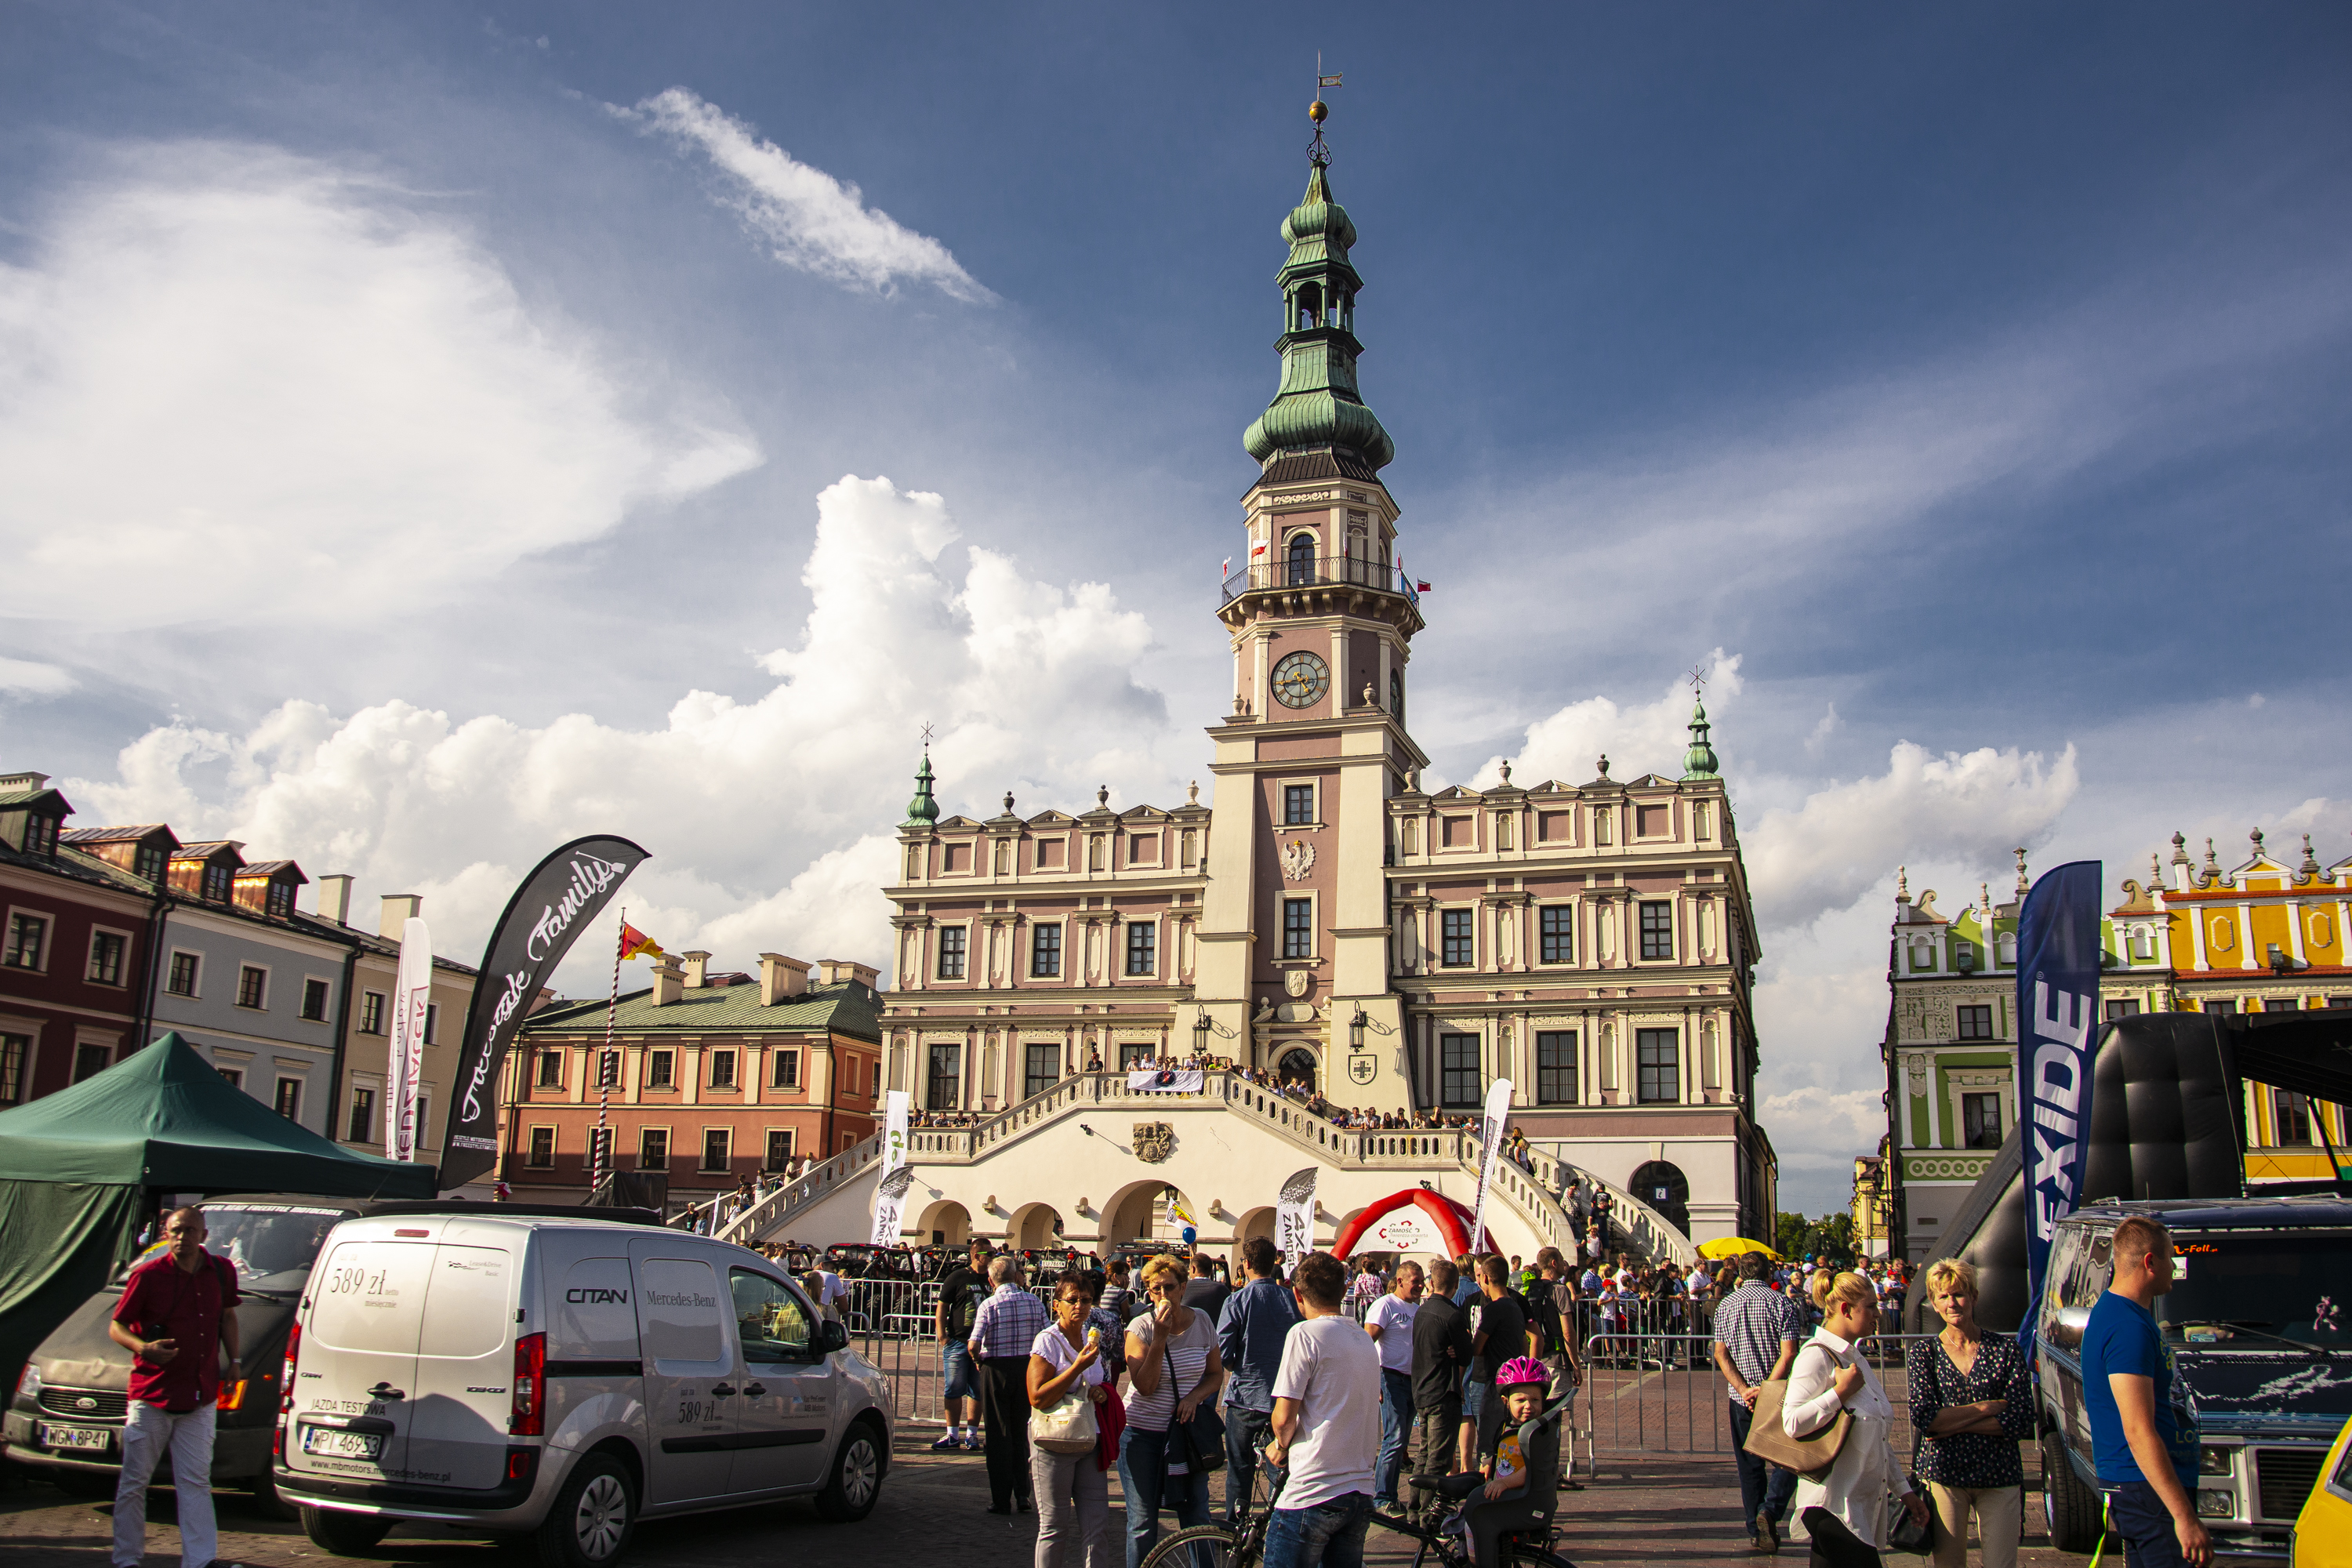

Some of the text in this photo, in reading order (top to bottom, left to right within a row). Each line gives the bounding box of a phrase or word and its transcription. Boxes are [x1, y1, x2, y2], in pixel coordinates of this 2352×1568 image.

[462, 859, 615, 1122] Freestyle Family
[289, 1207, 344, 1217] MOTOCROSS
[330, 1268, 365, 1295] 589
[367, 1269, 387, 1295] zł
[566, 1288, 628, 1304] CITAN
[646, 1290, 717, 1308] Mercedes-Benz
[310, 1399, 387, 1417] JAZDA TESTOWA
[678, 1401, 702, 1424] 589
[703, 1400, 715, 1422] zł
[812, 1403, 826, 1412] Motors
[77, 1430, 107, 1448] 8P41
[339, 1433, 379, 1454] 46953
[310, 1461, 452, 1482] www.mbmotors.mercedes-benz.pl
